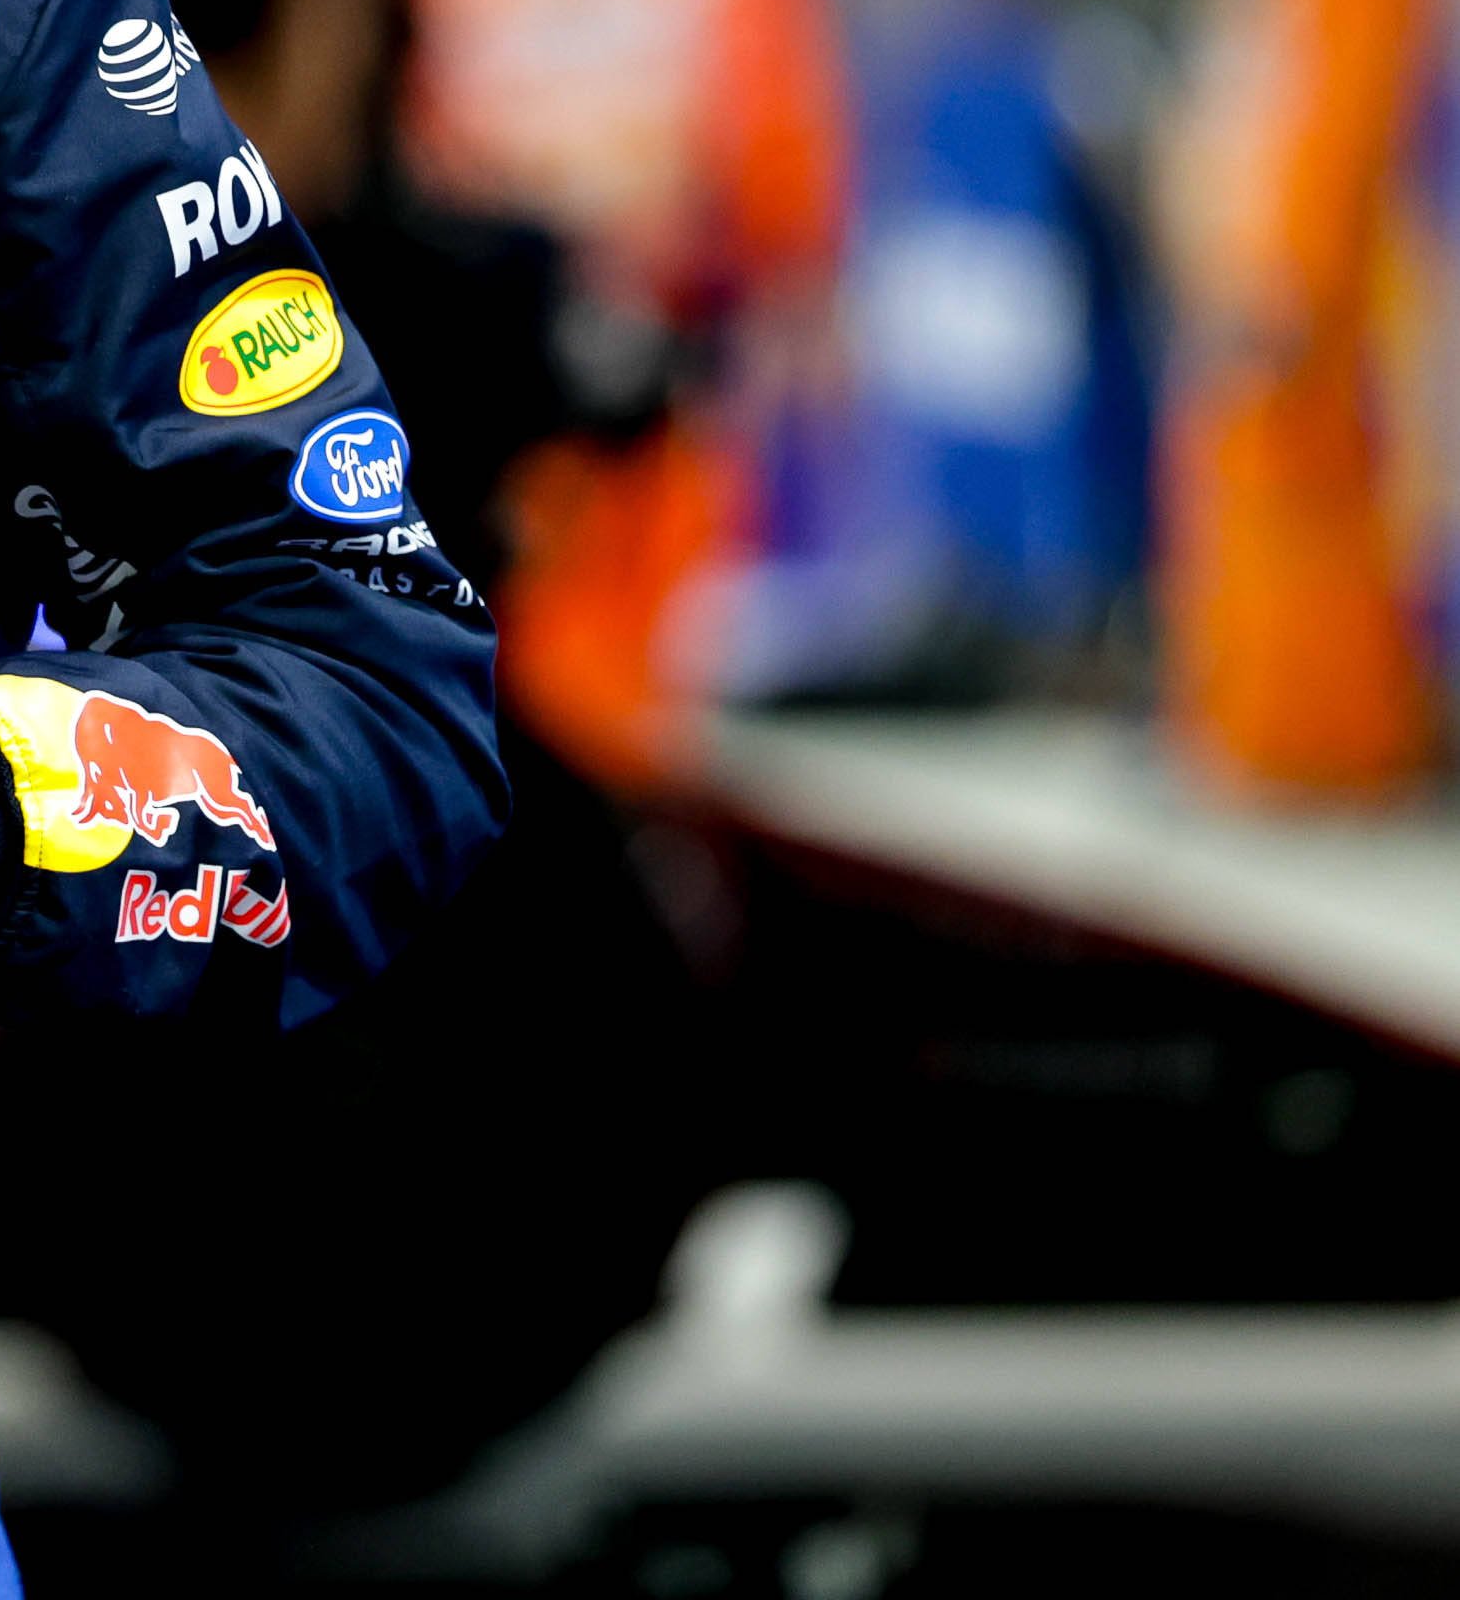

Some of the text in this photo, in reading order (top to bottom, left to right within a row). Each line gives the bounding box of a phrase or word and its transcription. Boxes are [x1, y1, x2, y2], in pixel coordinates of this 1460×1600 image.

[231, 291, 328, 379] RAUCH
[325, 428, 403, 506] Ford
[114, 863, 224, 943] Red
